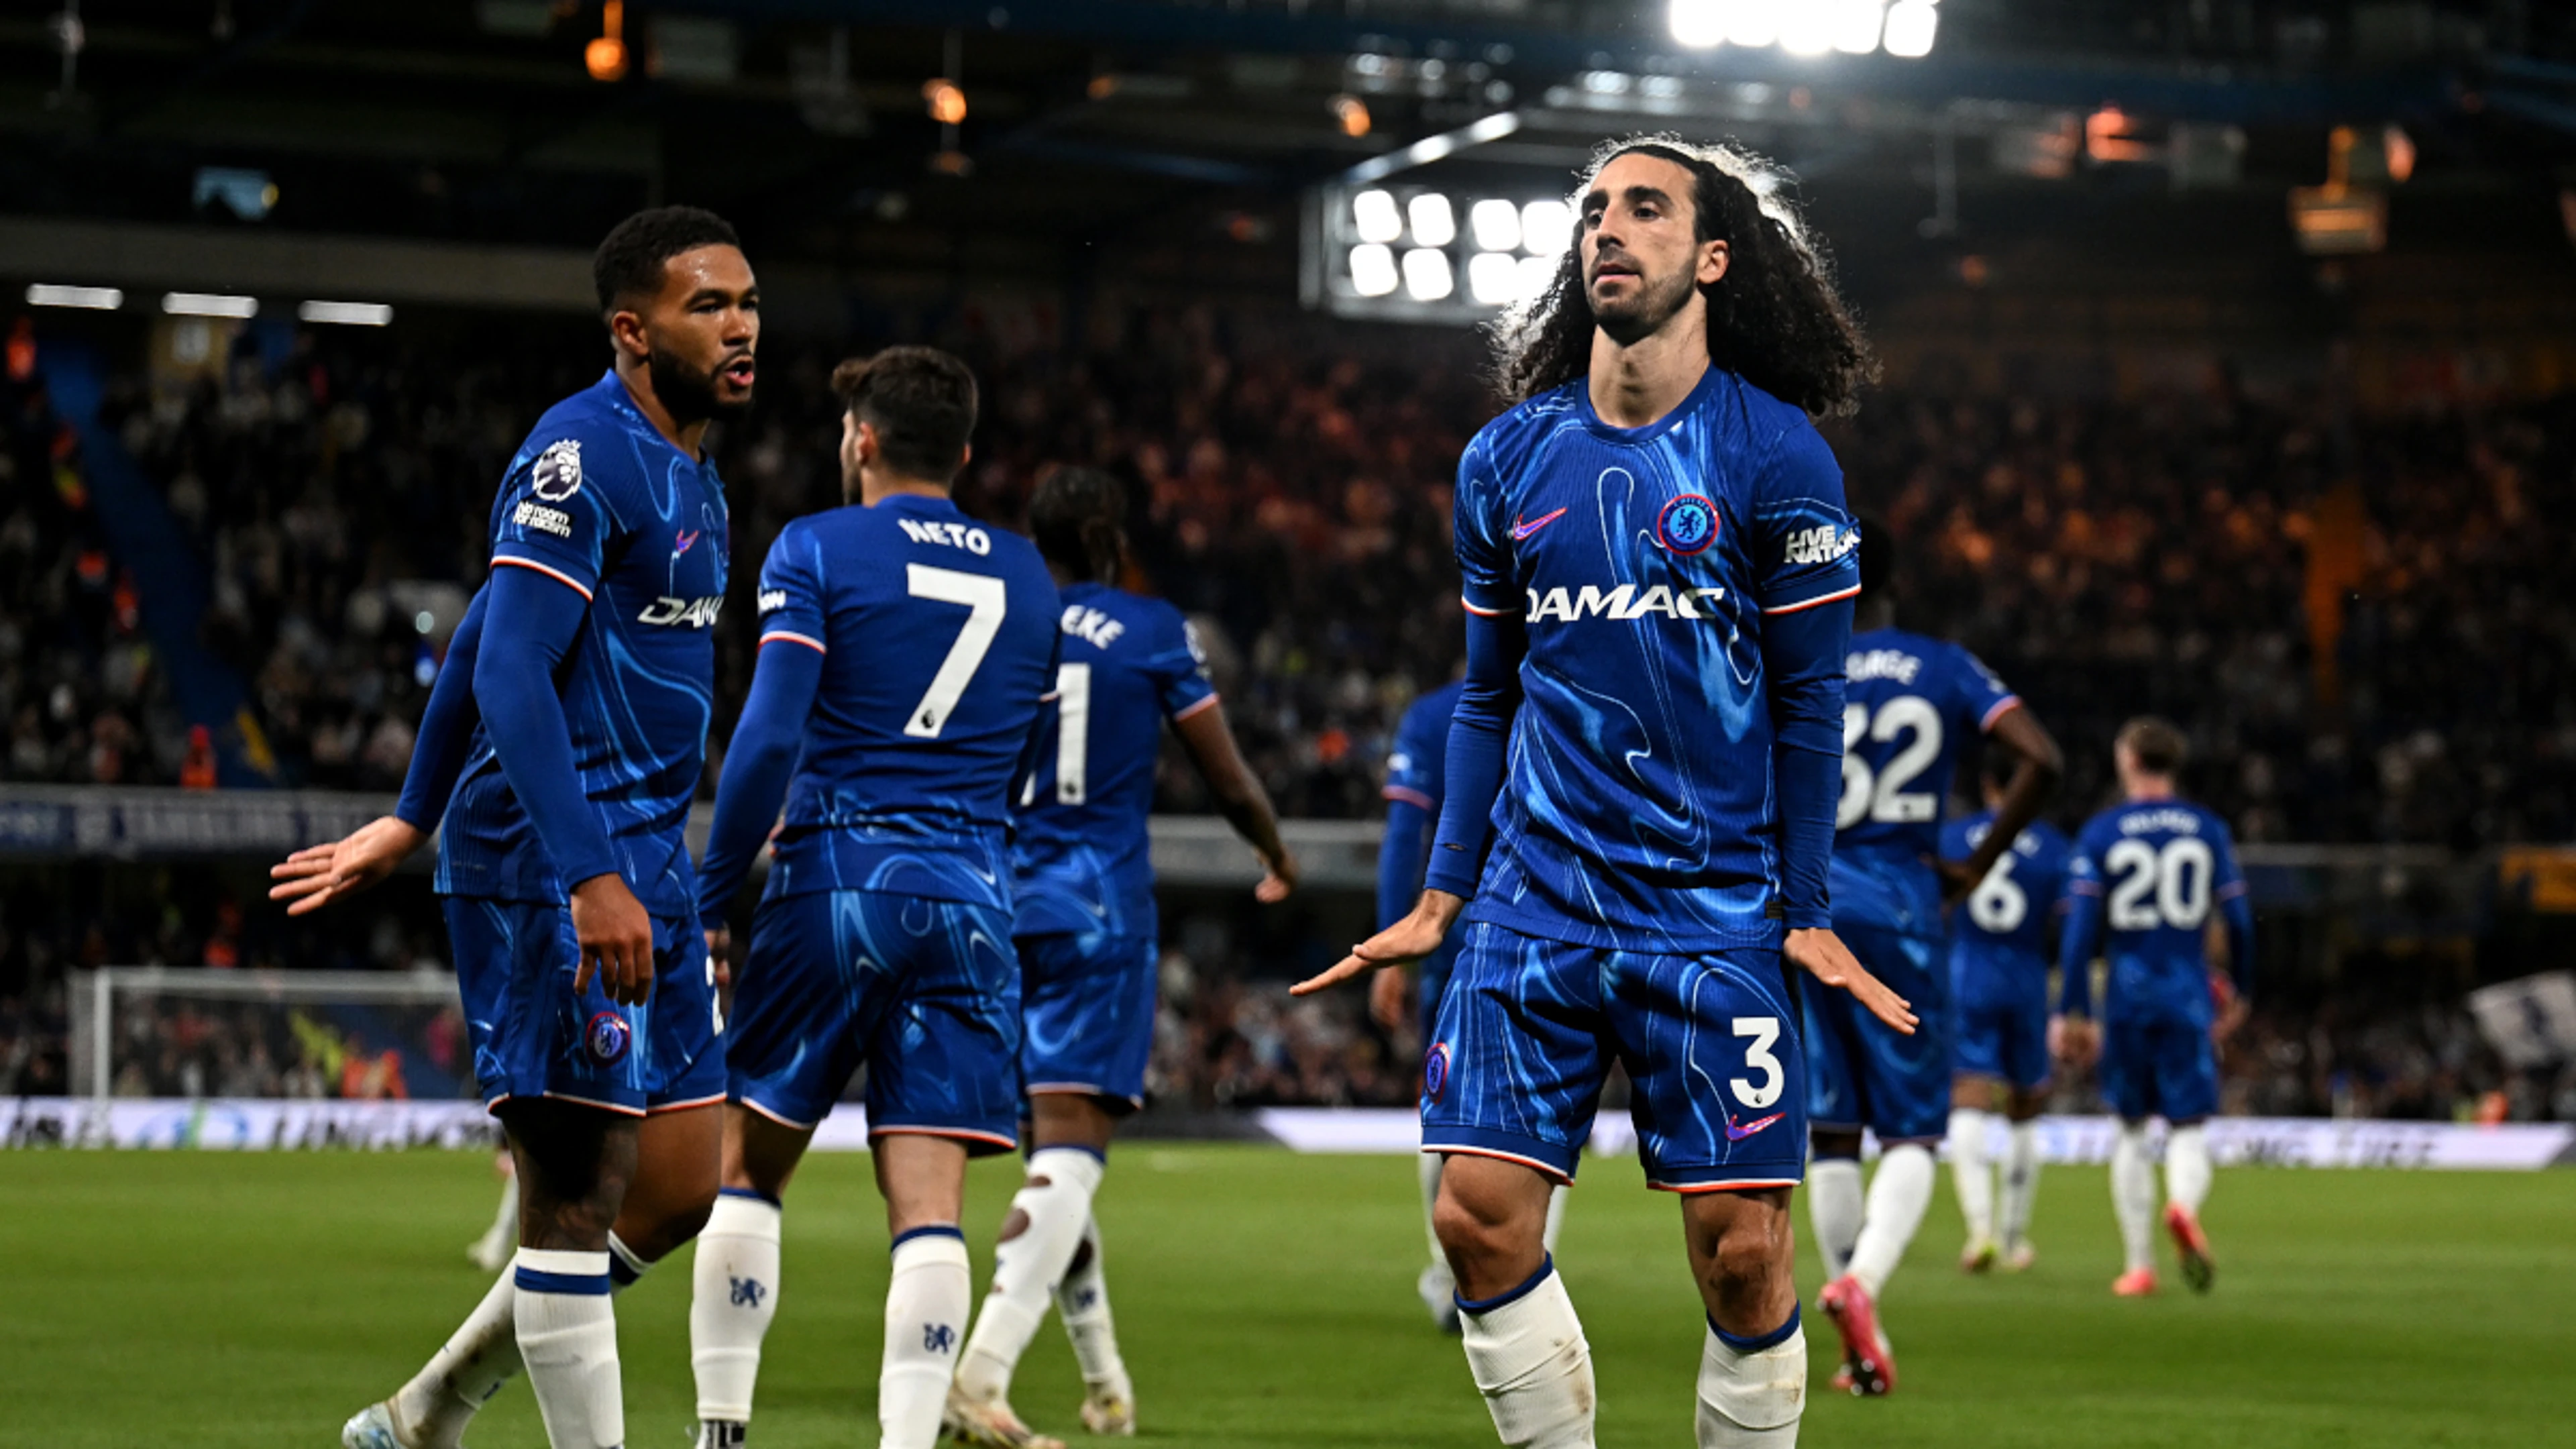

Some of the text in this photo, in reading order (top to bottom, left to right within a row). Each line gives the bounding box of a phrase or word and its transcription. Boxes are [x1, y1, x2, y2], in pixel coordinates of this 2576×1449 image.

[533, 505, 570, 526] room
[897, 518, 991, 556] NETO
[1787, 524, 1835, 549] LIVE
[1784, 527, 1862, 564] NATION
[637, 596, 724, 629] DAM
[1061, 604, 1125, 650] EKE
[903, 561, 1006, 738] 7
[1834, 695, 1943, 831] 32
[1967, 849, 2029, 933] 6
[2105, 837, 2214, 930] 20
[1729, 1017, 1784, 1108] 3
